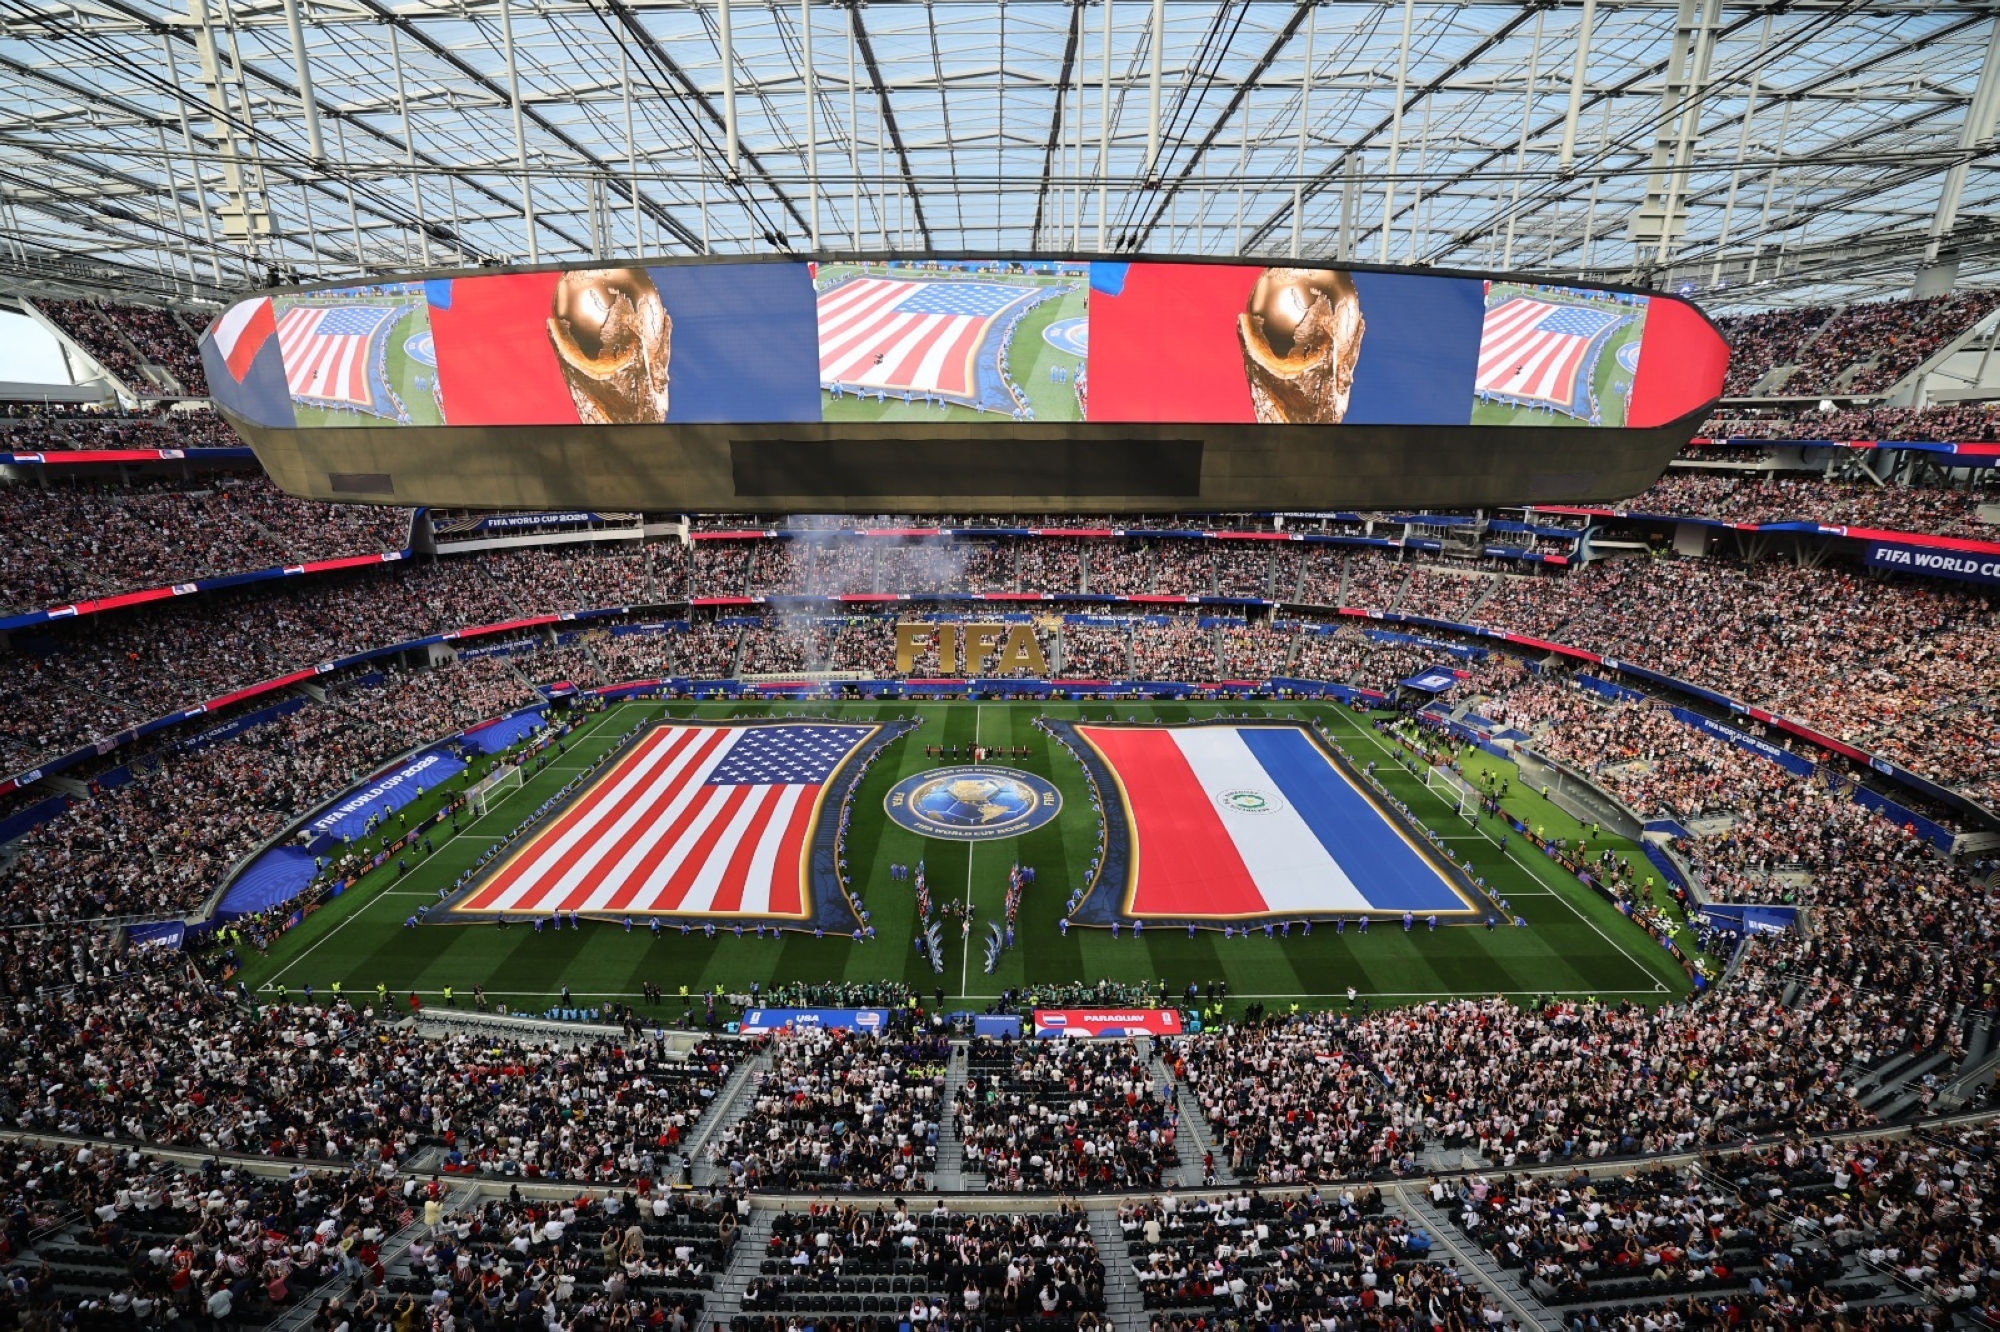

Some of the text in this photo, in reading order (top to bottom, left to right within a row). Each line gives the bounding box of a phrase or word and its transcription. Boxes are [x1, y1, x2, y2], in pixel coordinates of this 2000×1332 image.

[488, 513, 589, 527] FIFA WORLD CUP 2026
[1875, 548, 1911, 565] FIFA
[1914, 553, 1978, 574] WORLD
[896, 622, 1049, 674] FIFA
[1704, 720, 1719, 730] FIFA
[314, 755, 439, 829] FIFA WORLD CUP 2026
[913, 822, 934, 832] FIFA
[934, 827, 973, 837] WORLD
[973, 829, 995, 837] CUP
[796, 1014, 820, 1022] USA
[1083, 1014, 1145, 1022] PARAGUAY
